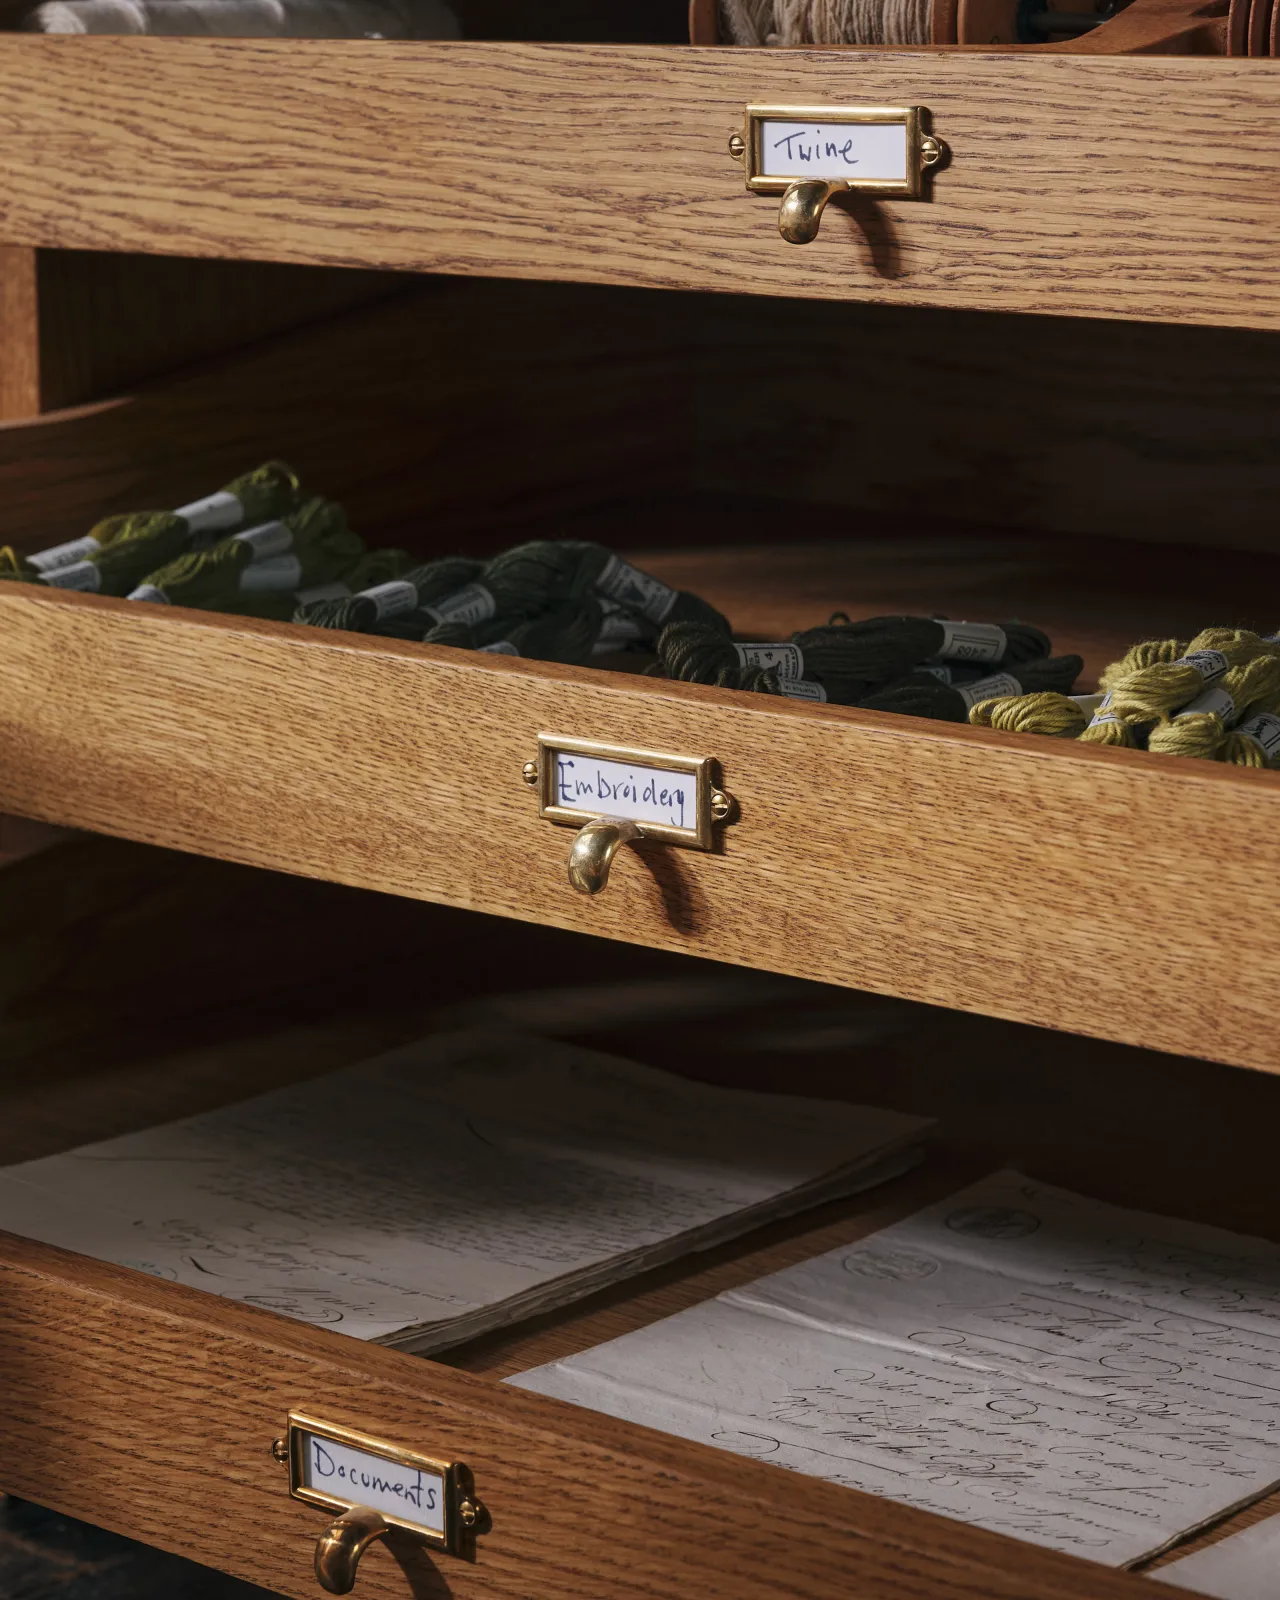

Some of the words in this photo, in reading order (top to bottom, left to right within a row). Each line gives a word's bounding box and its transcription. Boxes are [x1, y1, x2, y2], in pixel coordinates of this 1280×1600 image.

[774, 129, 859, 164] Twine
[558, 760, 685, 828] Embroidery
[312, 1440, 437, 1510] Documents
